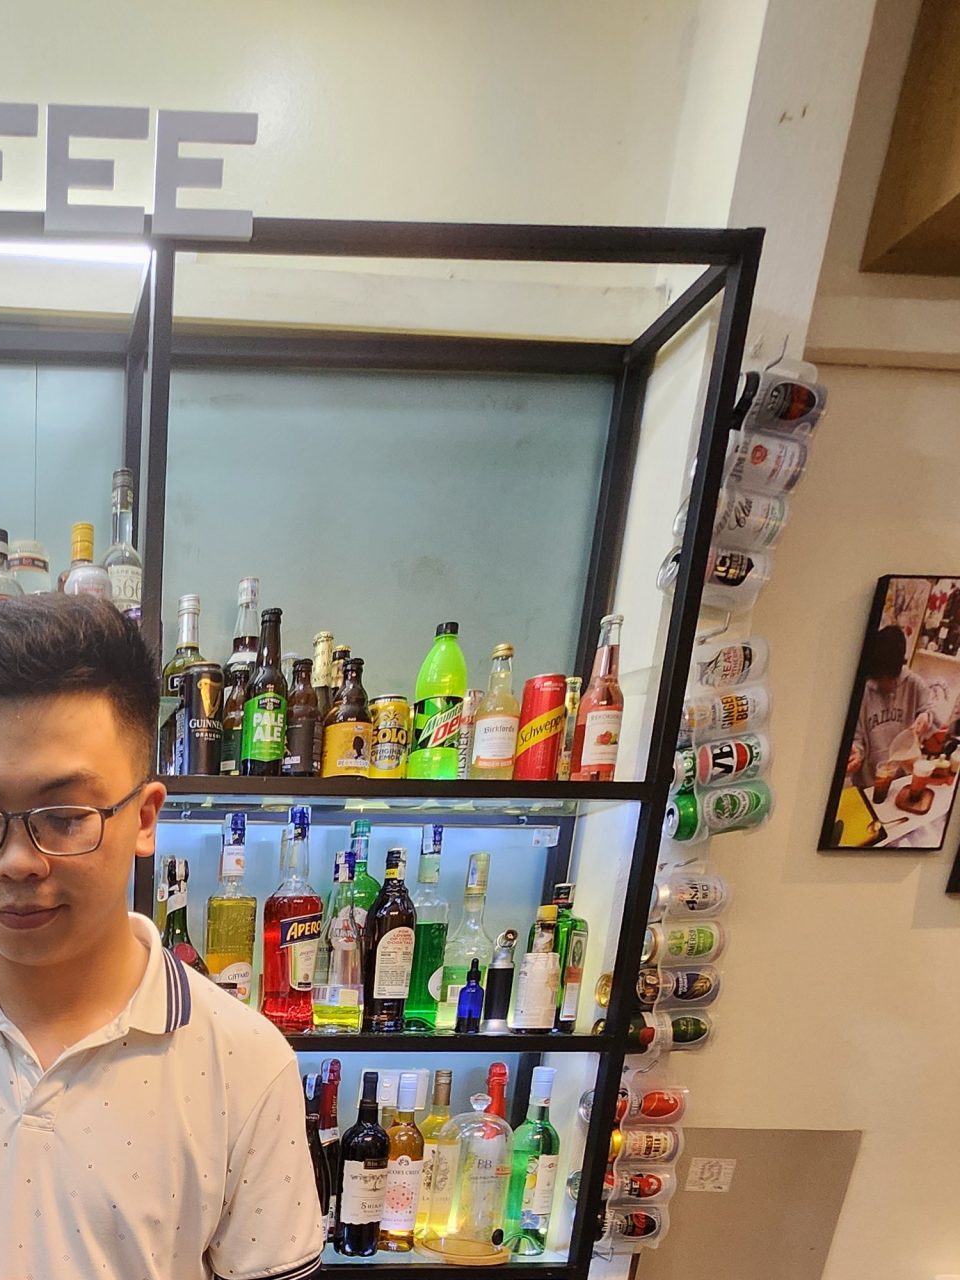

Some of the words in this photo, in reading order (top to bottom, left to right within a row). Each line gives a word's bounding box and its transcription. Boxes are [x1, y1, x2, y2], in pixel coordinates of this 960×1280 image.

[253, 713, 284, 728] PALE
[253, 726, 282, 742] ALE
[520, 714, 561, 747] Schwepp
[286, 920, 321, 941] APERO
